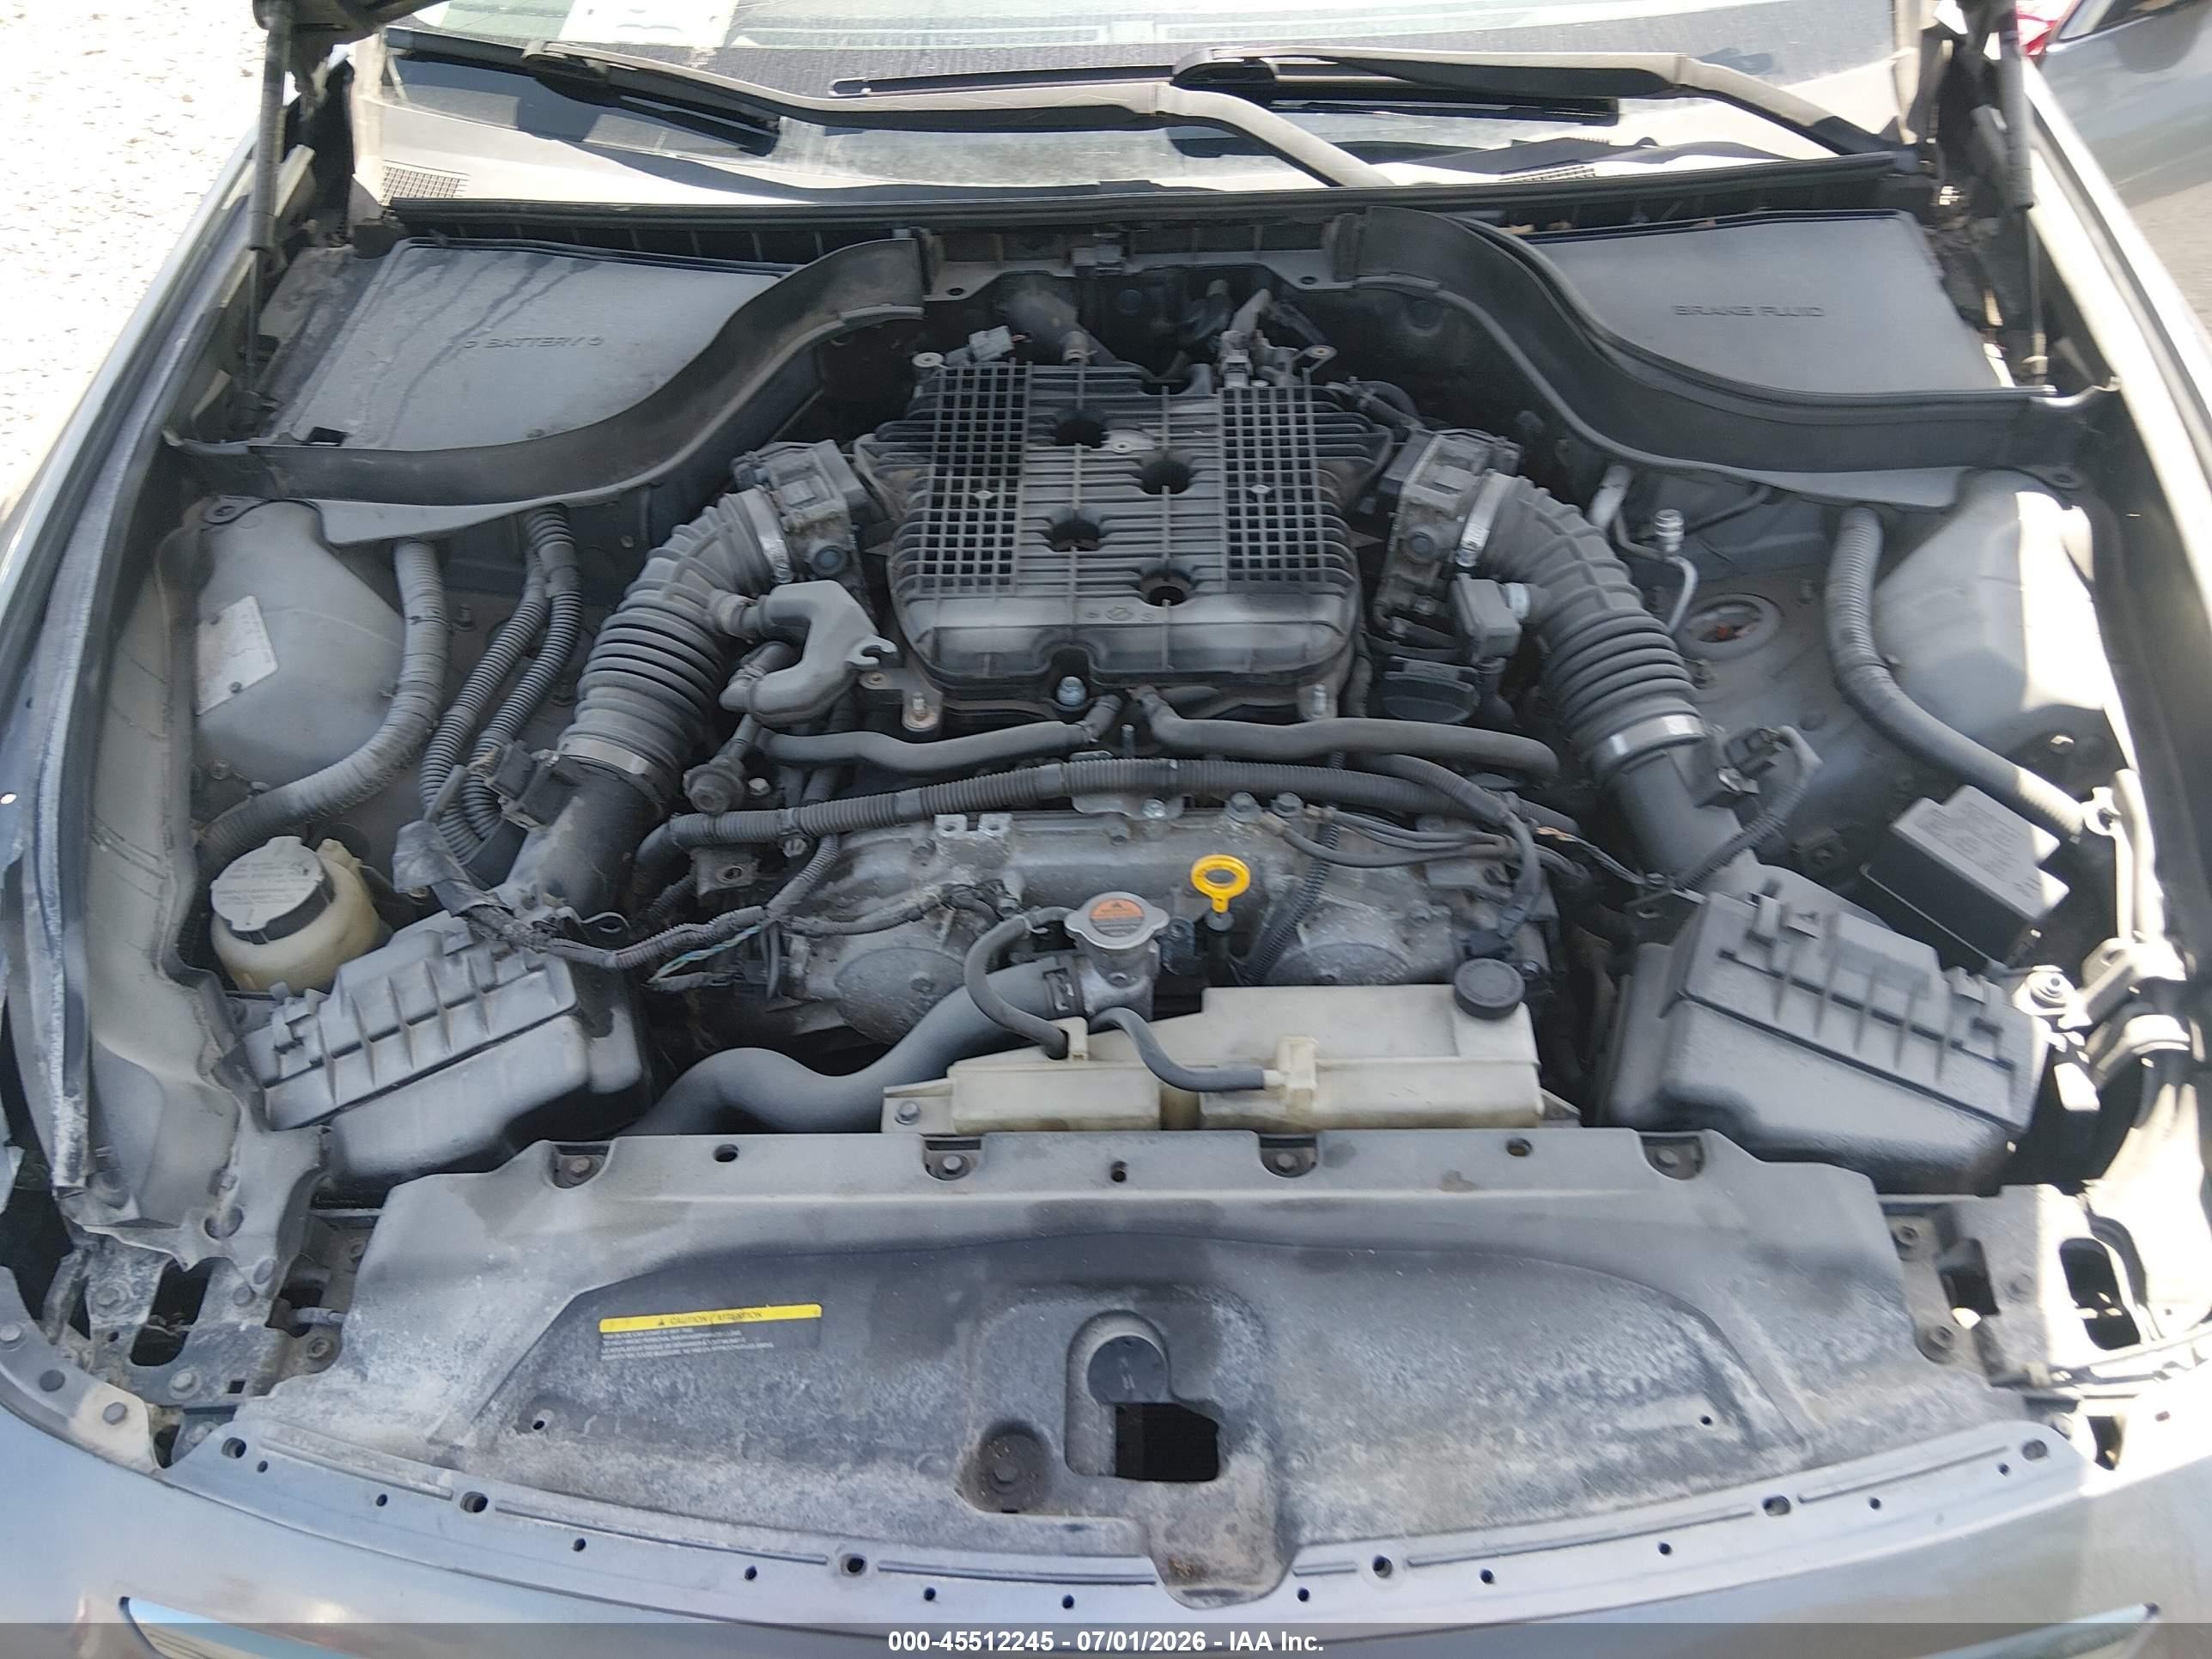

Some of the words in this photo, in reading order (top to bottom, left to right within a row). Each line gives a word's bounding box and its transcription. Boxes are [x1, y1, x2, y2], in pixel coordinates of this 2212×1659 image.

[1674, 305, 1754, 317] BRAKE
[1759, 306, 1826, 318] FLUID
[483, 337, 586, 349] BATTERY
